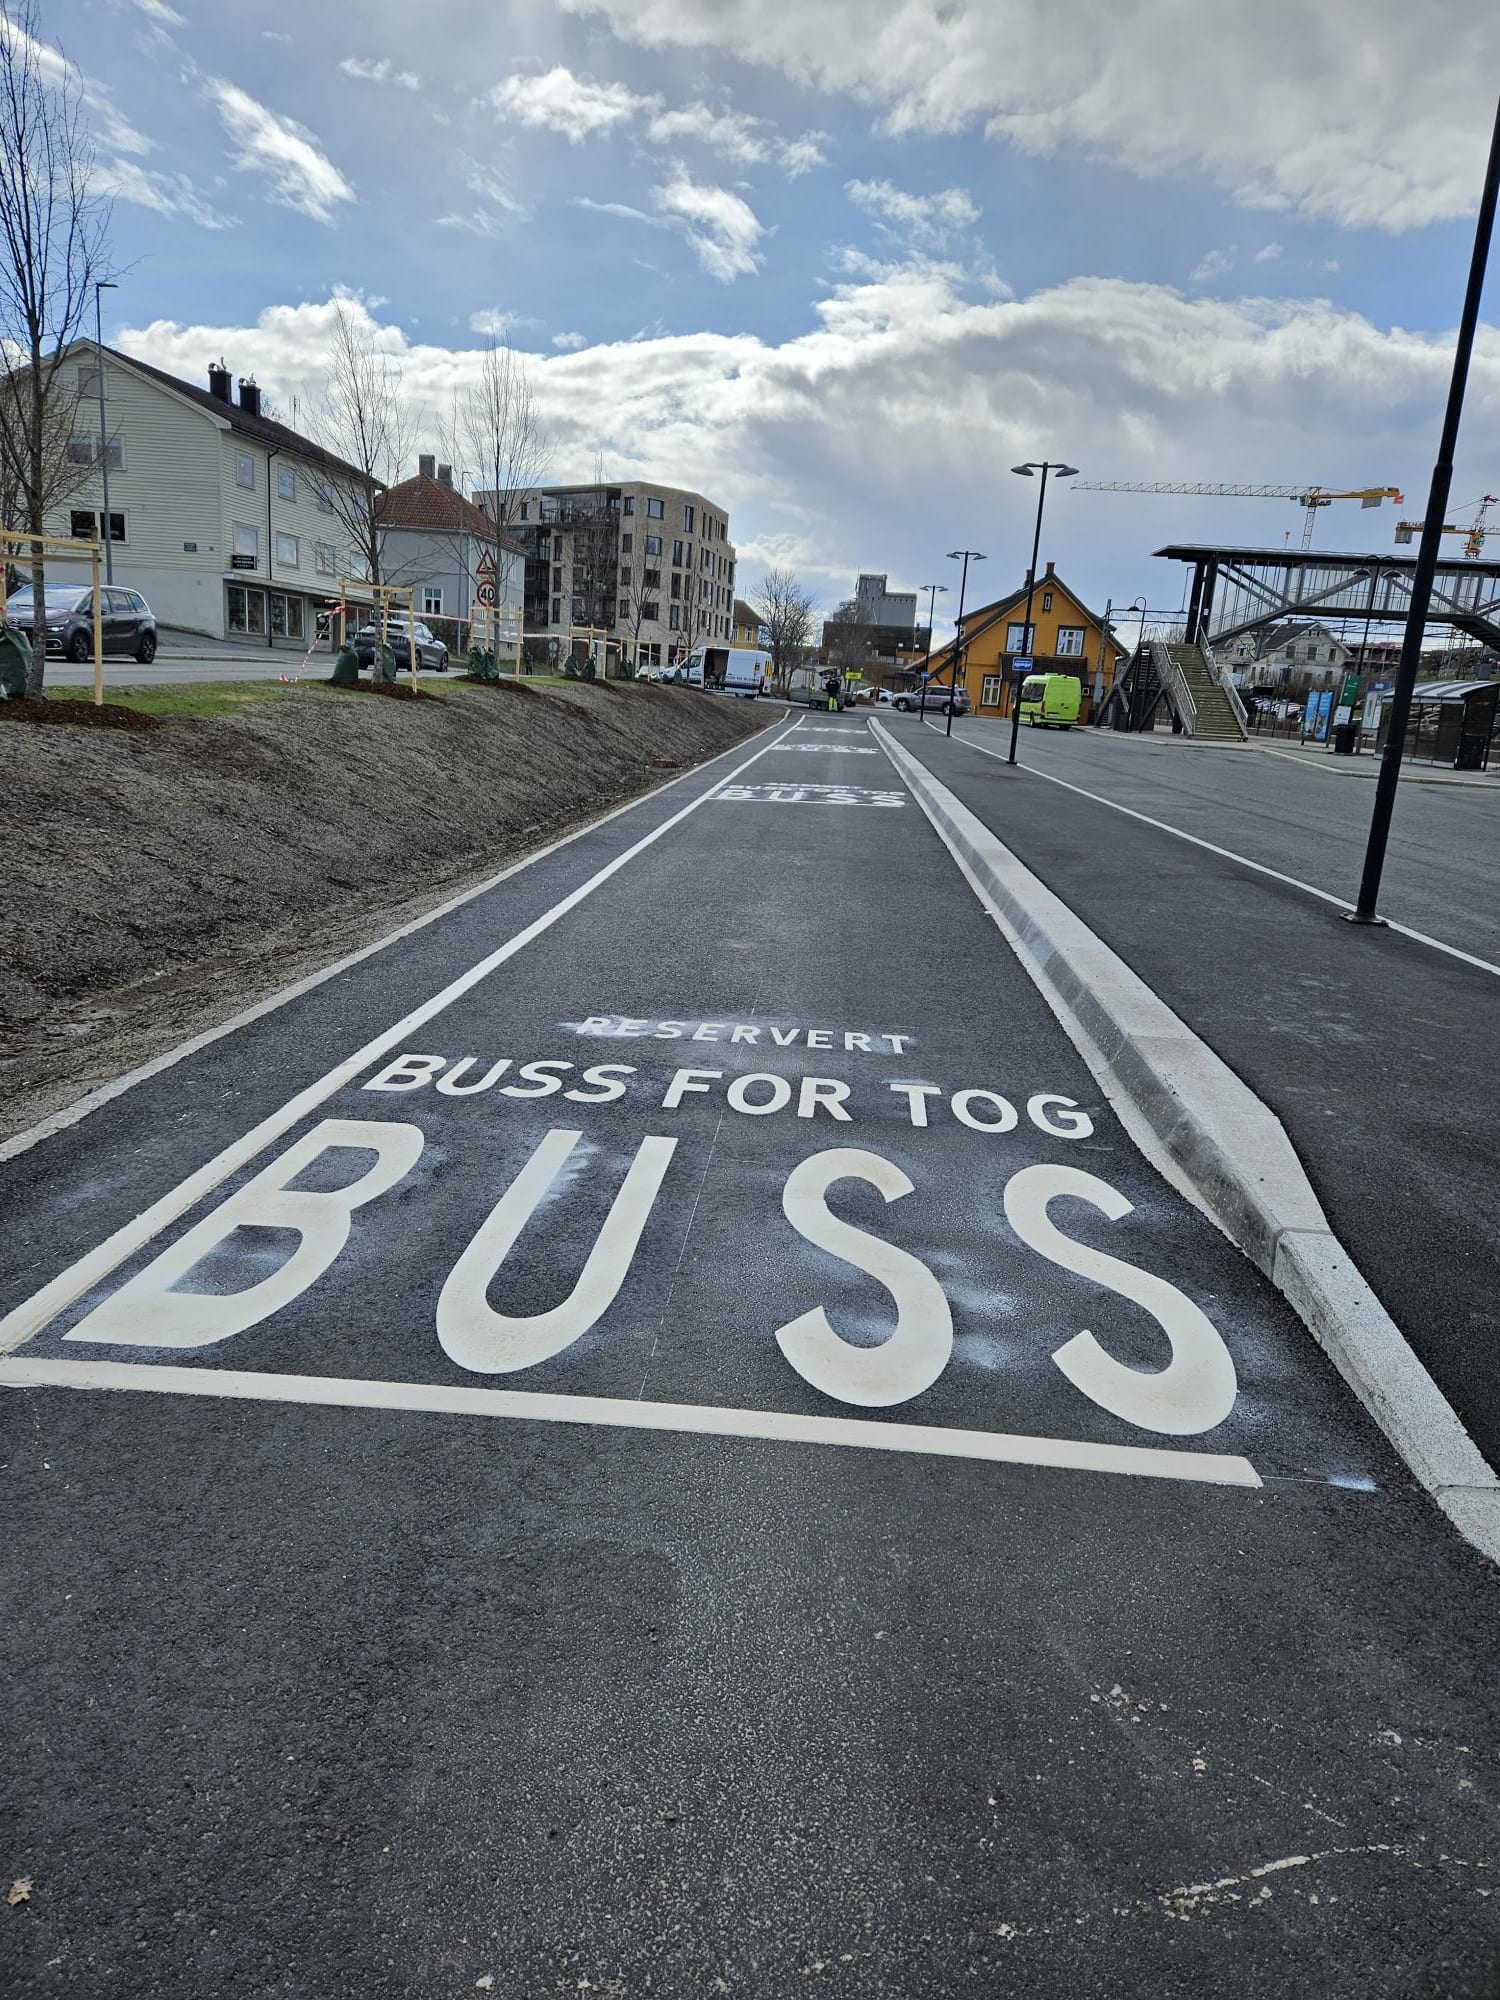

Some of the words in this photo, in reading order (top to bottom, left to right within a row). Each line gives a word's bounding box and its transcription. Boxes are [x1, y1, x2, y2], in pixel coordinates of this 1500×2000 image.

[481, 588, 495, 600] 40
[716, 789, 906, 807] BUSS
[576, 1016, 910, 1054] RESERVERT
[361, 1053, 638, 1103] BUSS
[661, 1069, 853, 1122] FOR
[890, 1083, 1094, 1140] TOG
[61, 1118, 1238, 1435] BUSS
